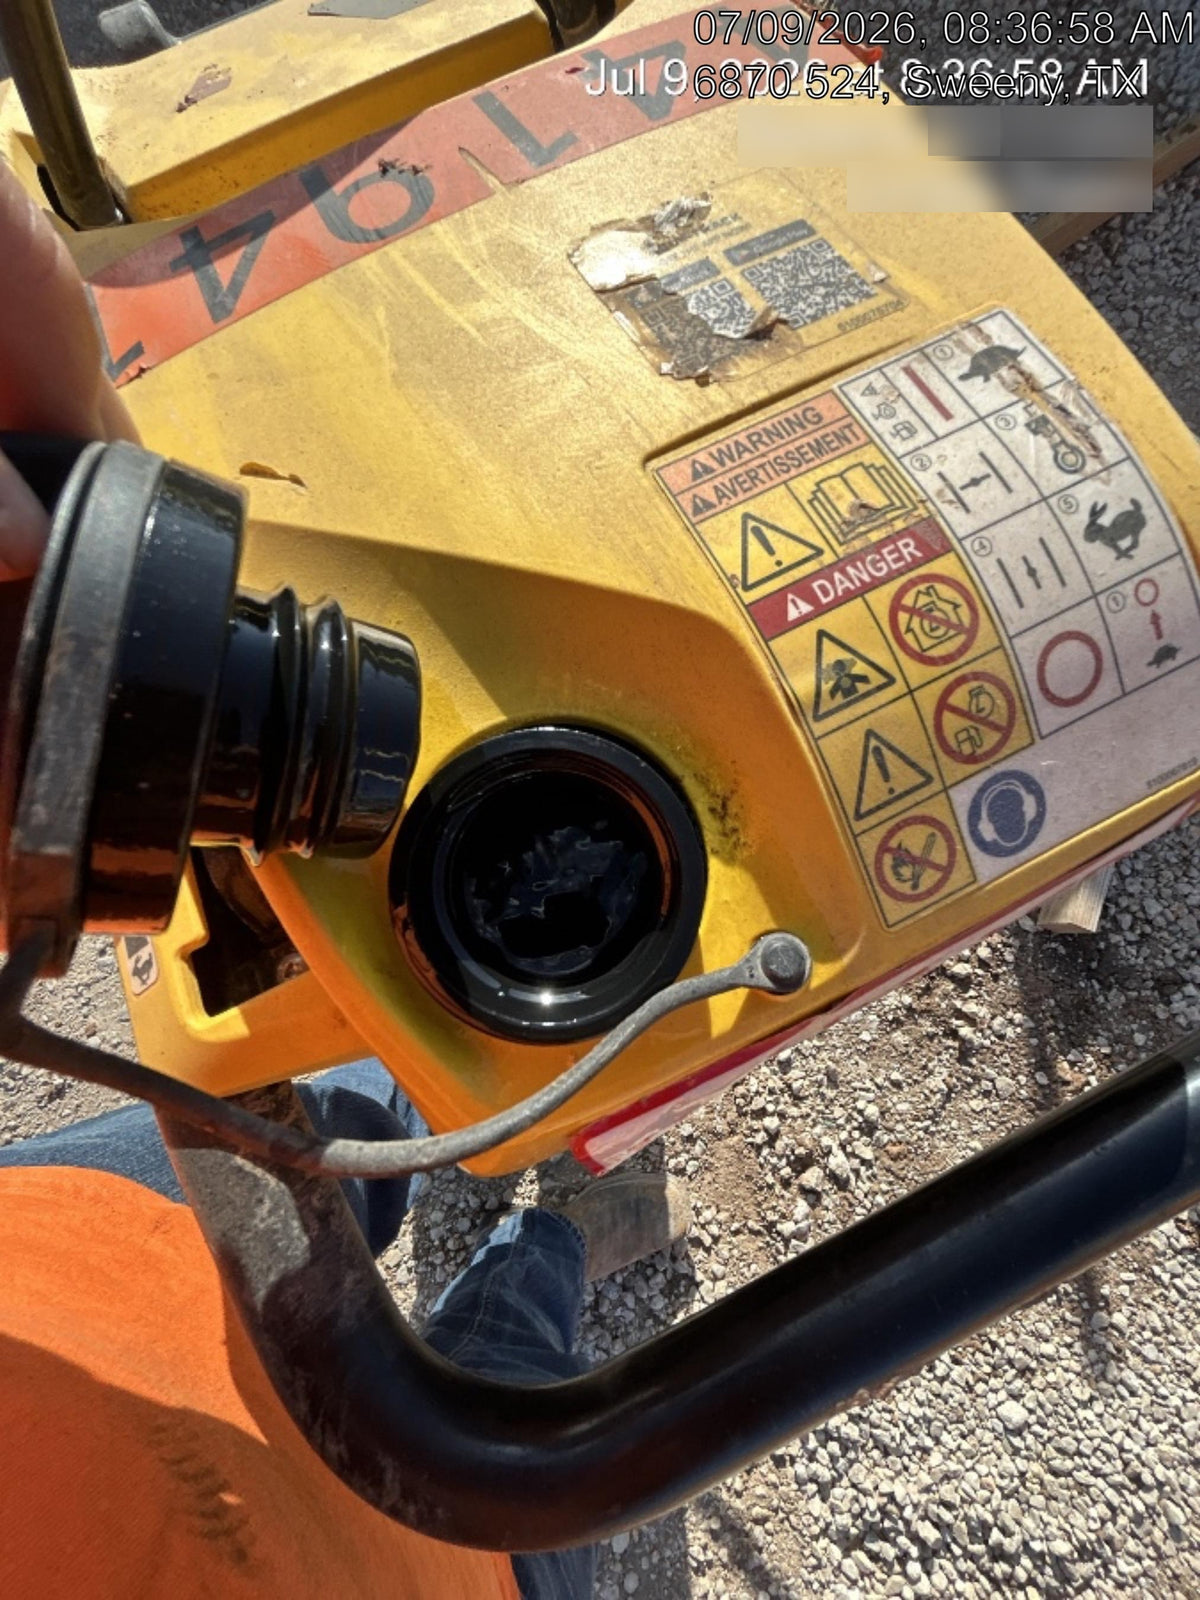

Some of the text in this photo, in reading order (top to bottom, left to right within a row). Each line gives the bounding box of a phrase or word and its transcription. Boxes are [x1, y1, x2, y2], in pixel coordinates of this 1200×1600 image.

[708, 406, 824, 468] WARNING
[712, 423, 861, 505] AVERTISSEMENT
[811, 537, 924, 605] DANGER
